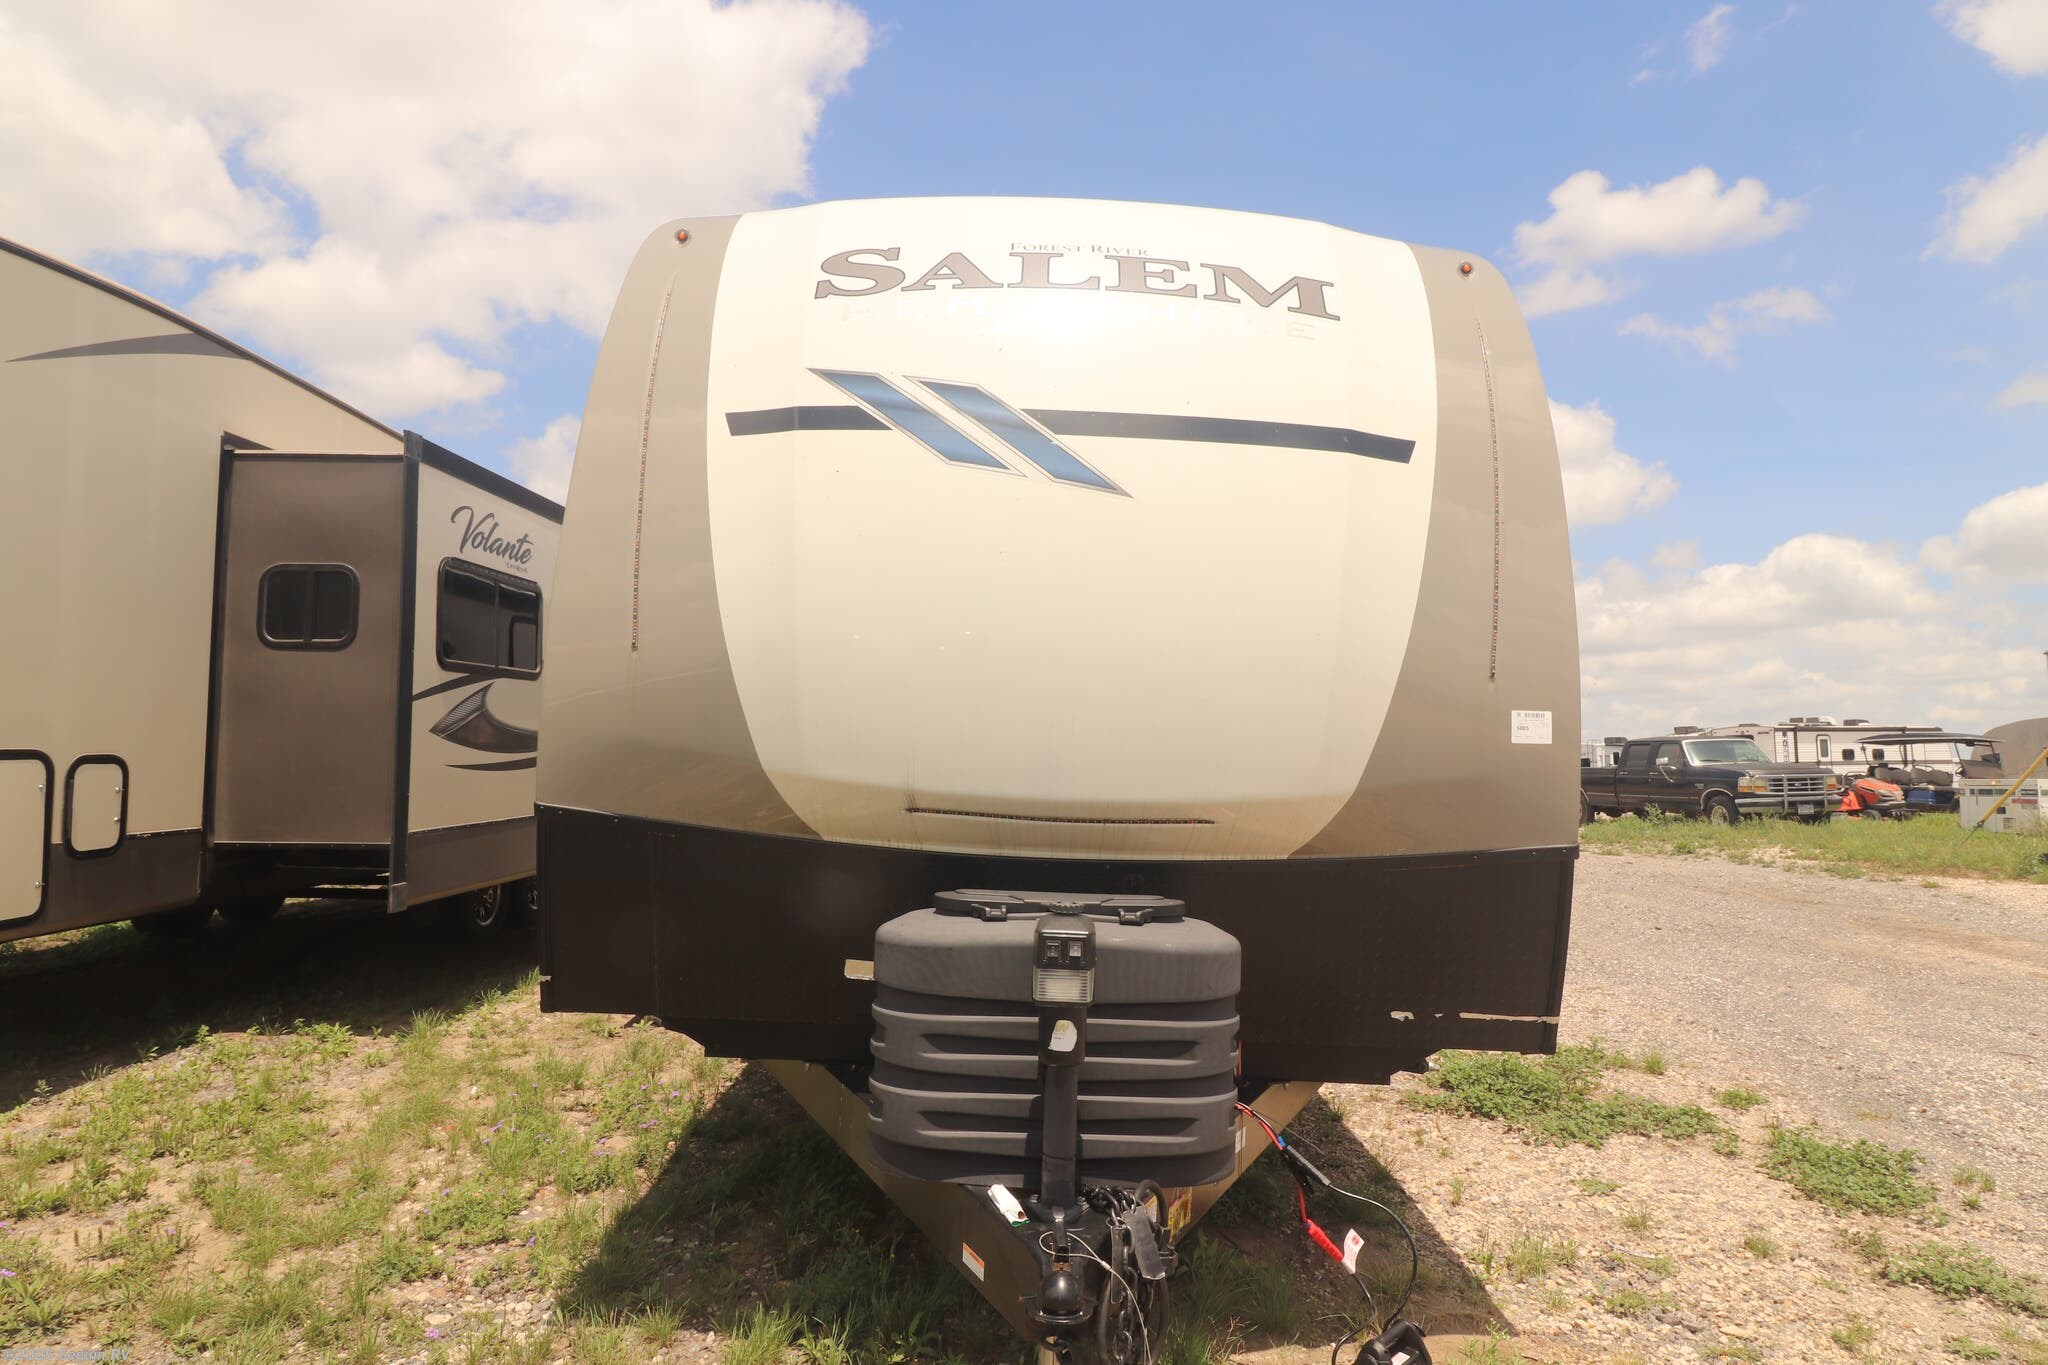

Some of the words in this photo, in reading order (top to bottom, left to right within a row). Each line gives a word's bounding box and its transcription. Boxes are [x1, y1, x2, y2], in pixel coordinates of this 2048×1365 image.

[1010, 243, 1084, 252] FOREST
[1091, 245, 1149, 256] RIVER
[814, 247, 1341, 321] SALEM
[451, 506, 534, 564] Volante
